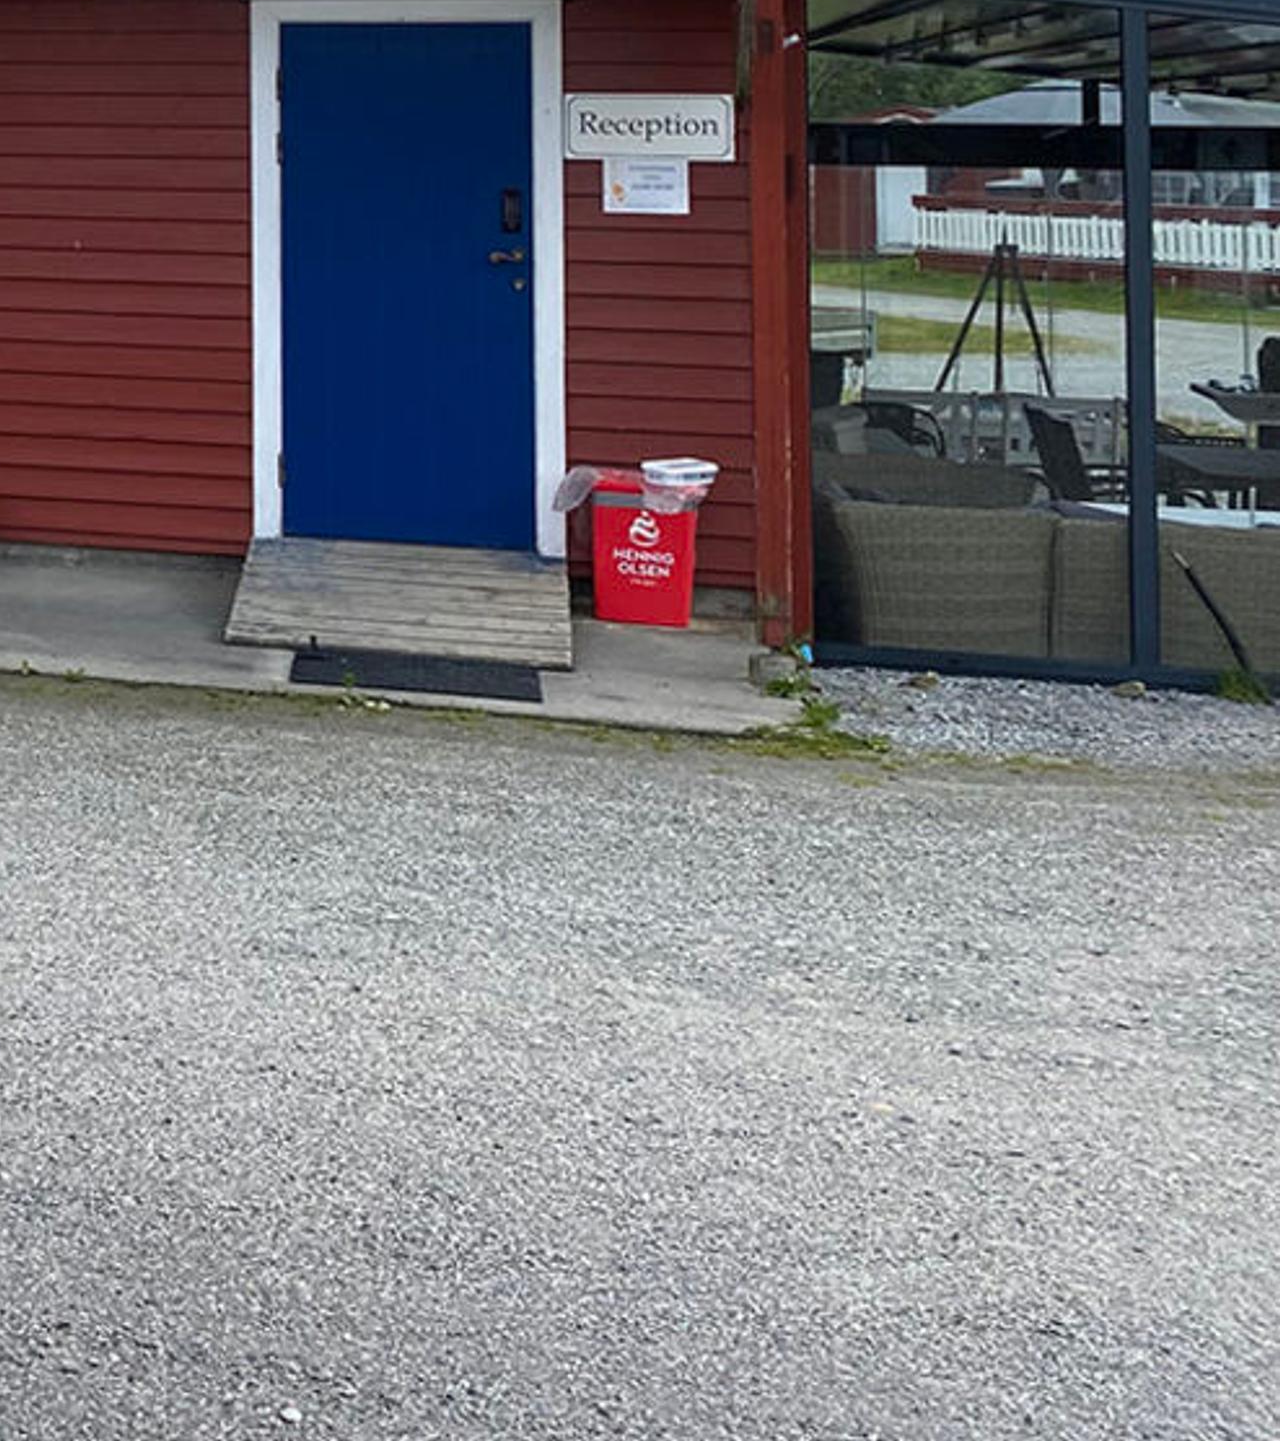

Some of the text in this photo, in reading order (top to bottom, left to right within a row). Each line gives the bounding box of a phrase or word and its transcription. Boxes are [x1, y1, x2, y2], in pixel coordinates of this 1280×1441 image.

[579, 111, 719, 142] Reception
[613, 547, 675, 565] HENNIG
[617, 561, 671, 577] OLSEN
